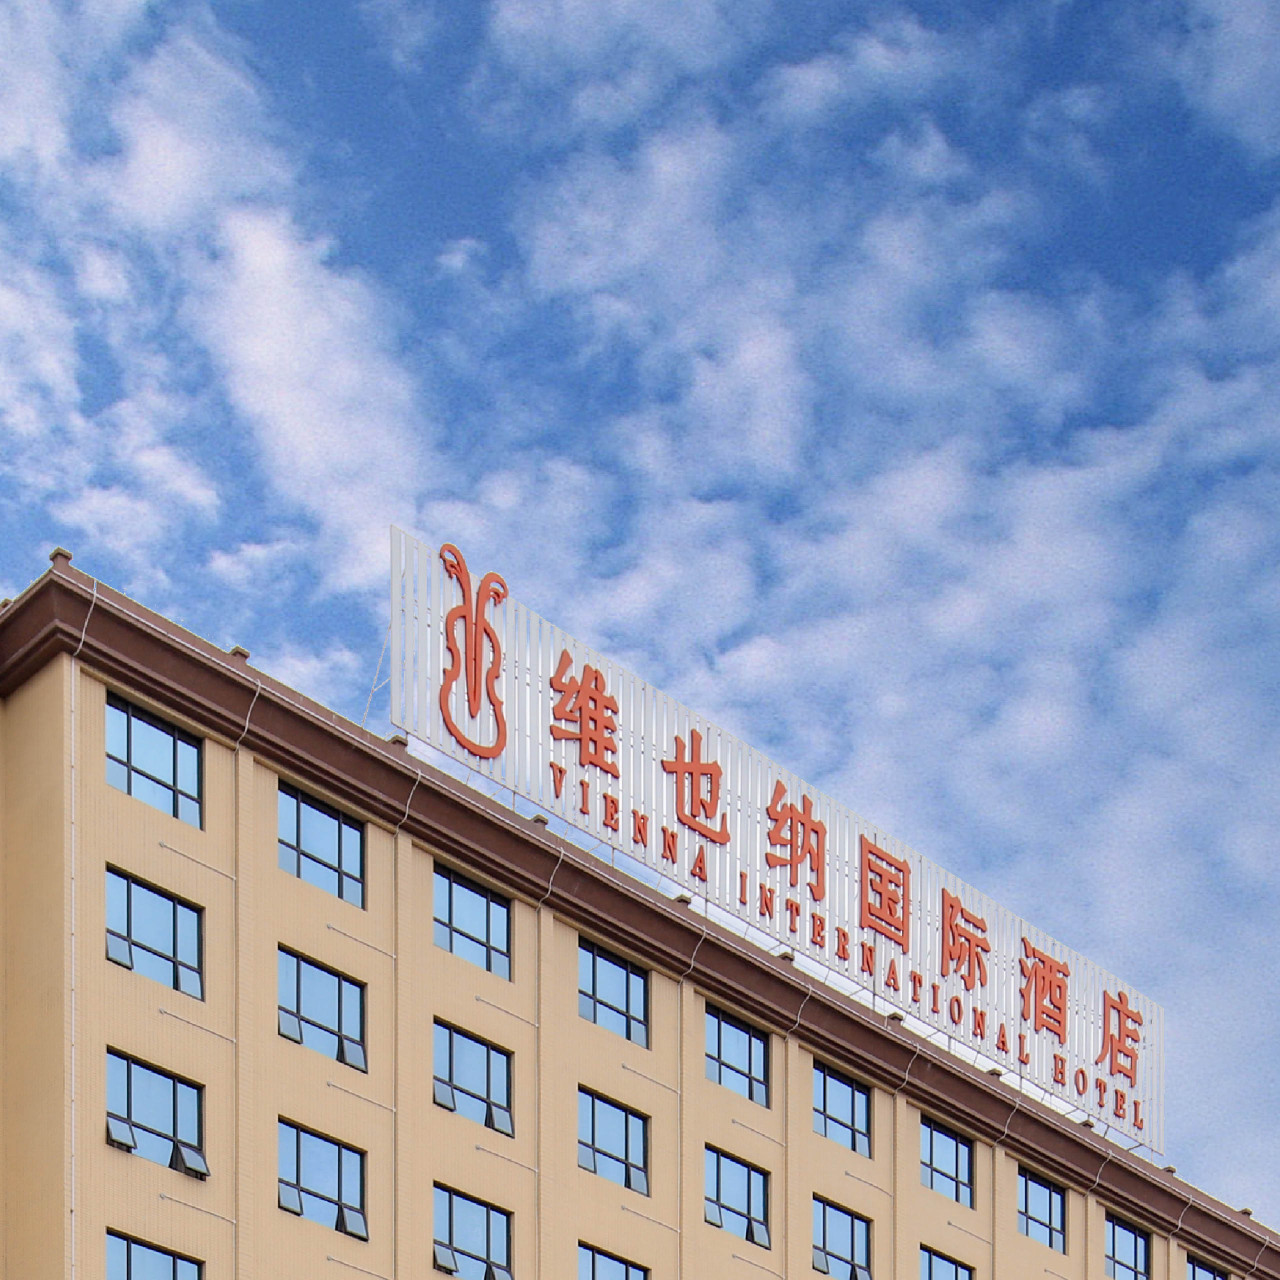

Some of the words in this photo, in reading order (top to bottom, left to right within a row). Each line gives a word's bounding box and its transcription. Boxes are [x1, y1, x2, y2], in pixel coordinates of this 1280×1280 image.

[549, 648, 1143, 1088] 维也纳国际酒店
[549, 761, 708, 882] VIENNA
[739, 868, 1030, 1066] INTERNATIONAL
[1053, 1051, 1145, 1131] HOTEL
